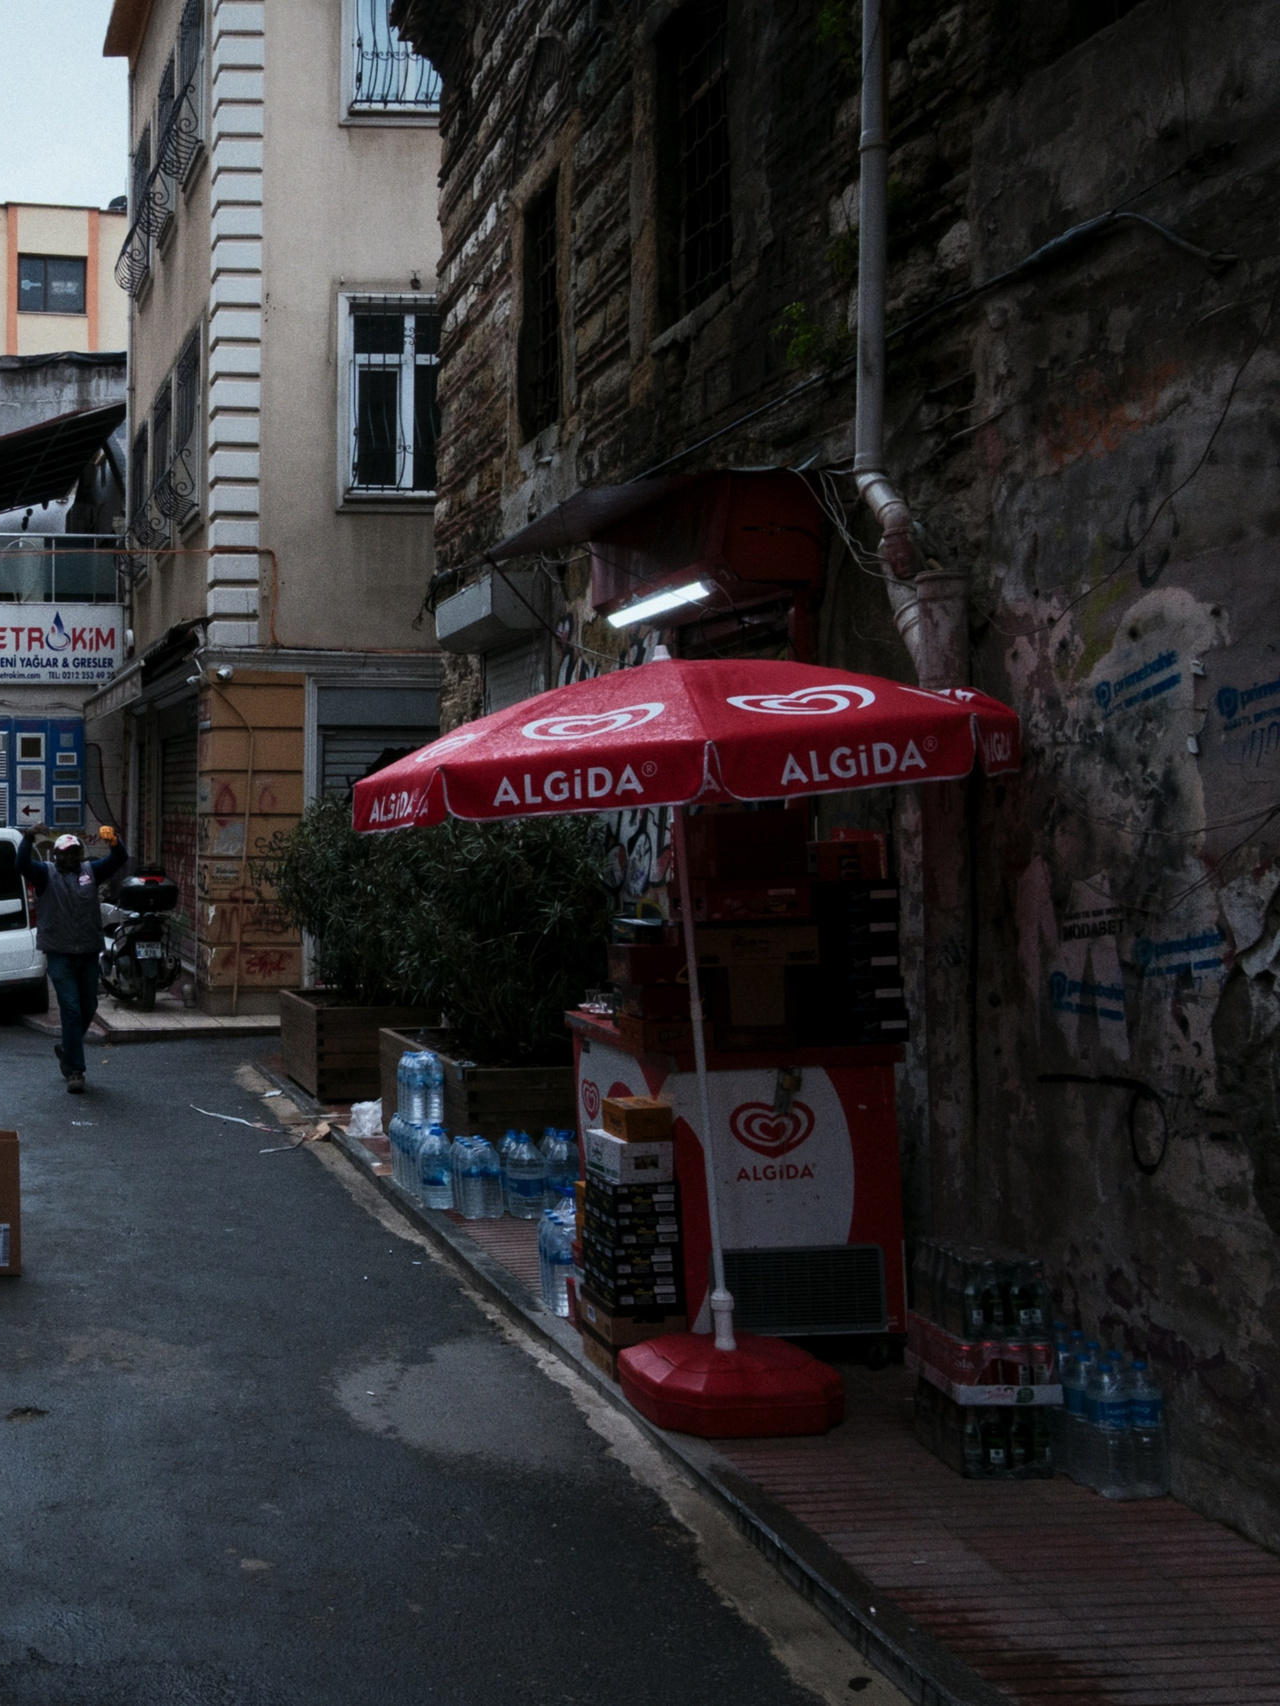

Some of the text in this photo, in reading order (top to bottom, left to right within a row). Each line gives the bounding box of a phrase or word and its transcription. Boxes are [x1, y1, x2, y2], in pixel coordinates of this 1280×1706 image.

[20, 655, 59, 668] YAĞLAR
[61, 657, 70, 668] &
[72, 657, 114, 668] GRESLER
[48, 671, 61, 680] TEL:
[62, 671, 80, 680] 0212
[81, 671, 95, 680] 253
[96, 671, 106, 680] 49
